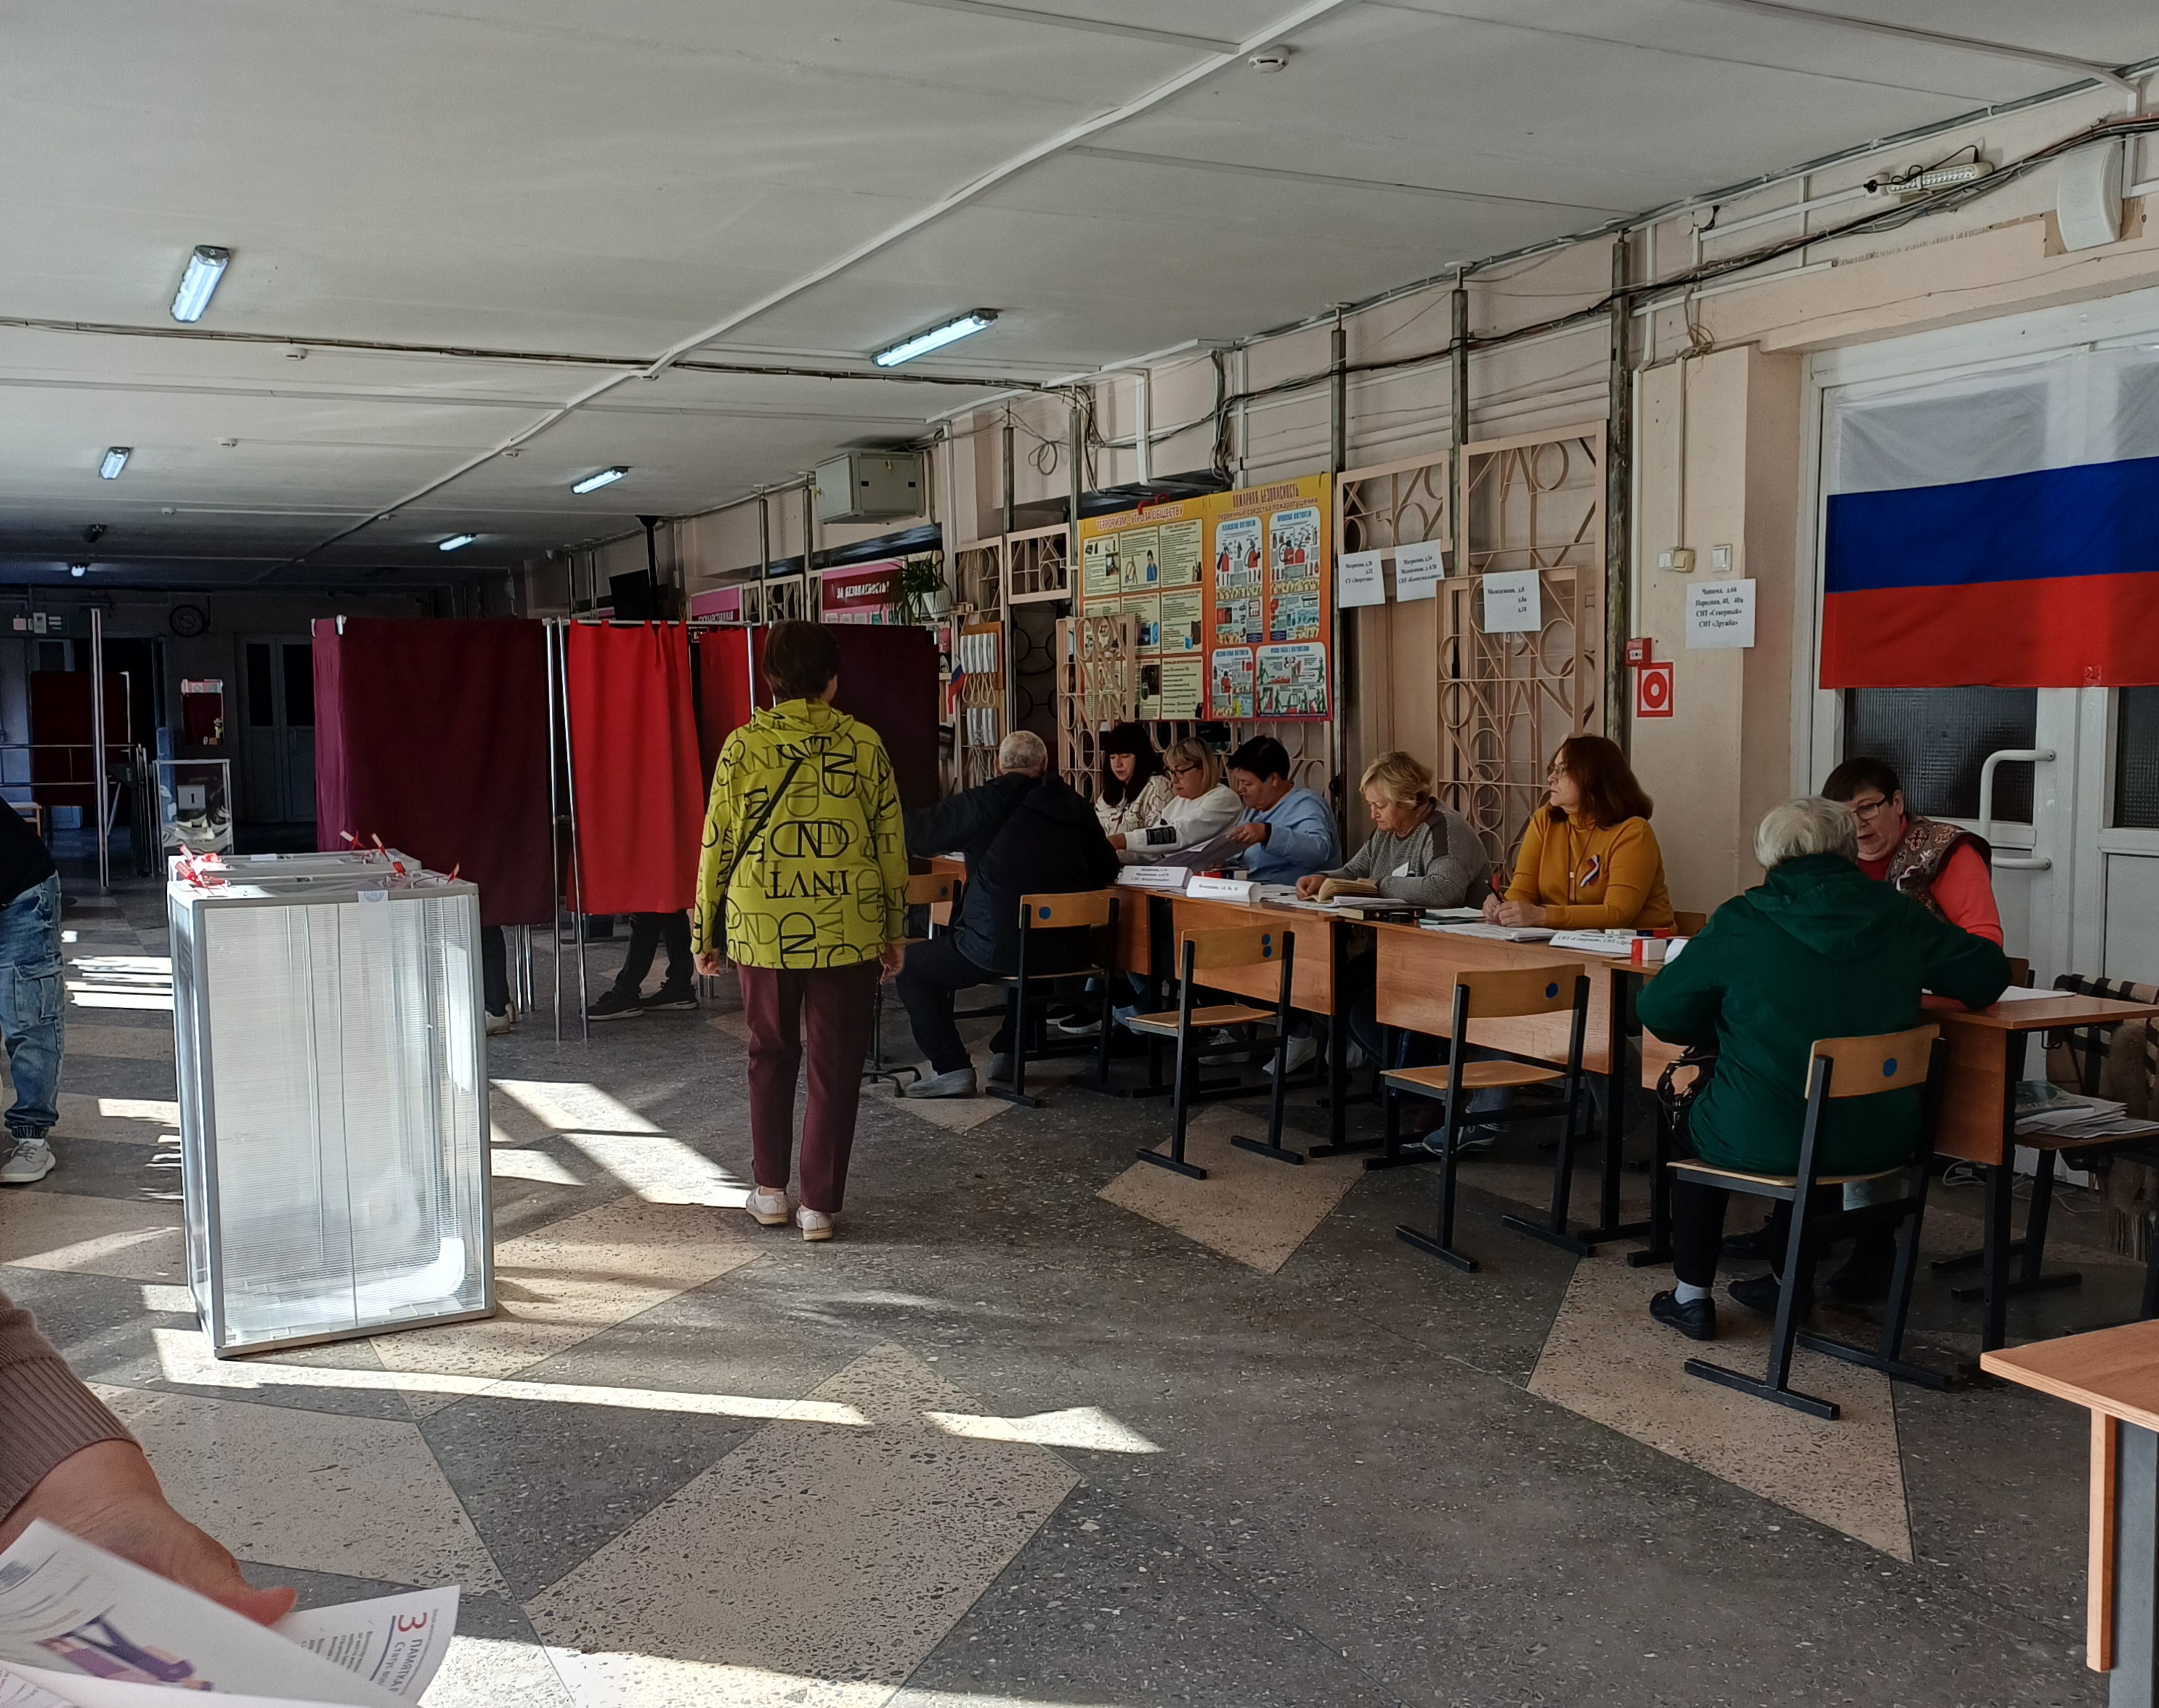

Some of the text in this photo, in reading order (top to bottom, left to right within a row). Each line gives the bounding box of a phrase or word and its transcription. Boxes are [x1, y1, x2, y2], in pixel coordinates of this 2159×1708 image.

[1233, 483, 1299, 508] ПОЖАРНАЯ БЕЗОПАСНОСТЬ
[1097, 516, 1126, 530] ТЕРРОРИЗМ
[1131, 512, 1150, 525] УГРОЗА
[1152, 506, 1183, 521] ОБЩЕСТВУ
[1218, 497, 1318, 520] первичные средства пожаротушения
[845, 580, 889, 598] БЕЗОПАСНОСТЬ!
[191, 793, 195, 804] 1
[397, 1612, 427, 1632] 3
[384, 1642, 405, 1670] Статус
[390, 1639, 423, 1687] ПАМЯТКА
